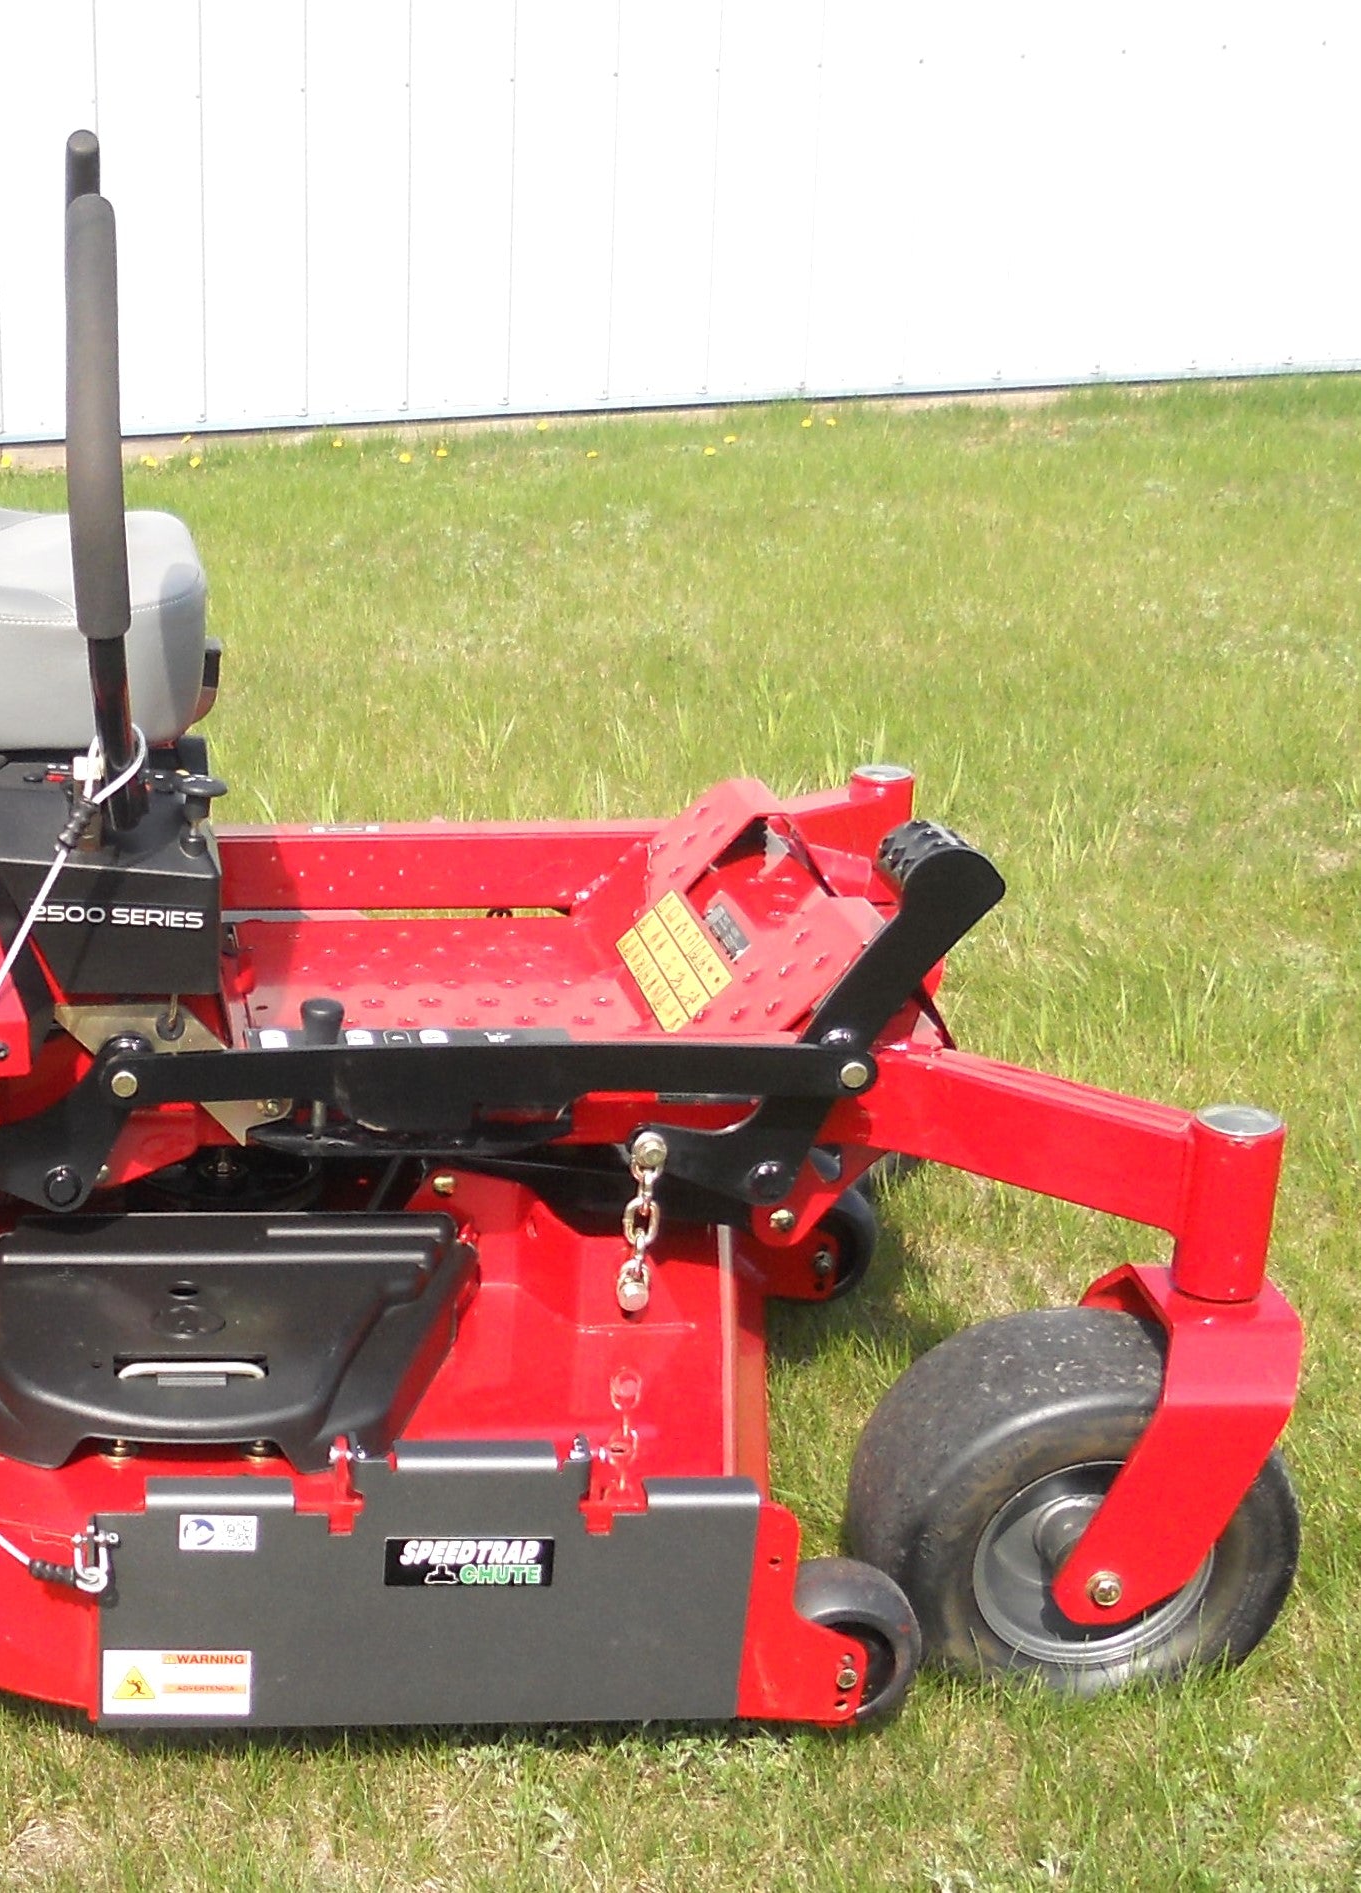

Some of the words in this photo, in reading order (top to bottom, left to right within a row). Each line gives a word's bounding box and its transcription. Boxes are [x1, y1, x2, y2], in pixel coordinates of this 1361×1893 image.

[31, 905, 106, 923] 2500
[111, 907, 204, 929] SERIES
[399, 1540, 541, 1565] SPEEDTRAP
[459, 1564, 542, 1584] CHUTE
[177, 1654, 245, 1665] WARNING
